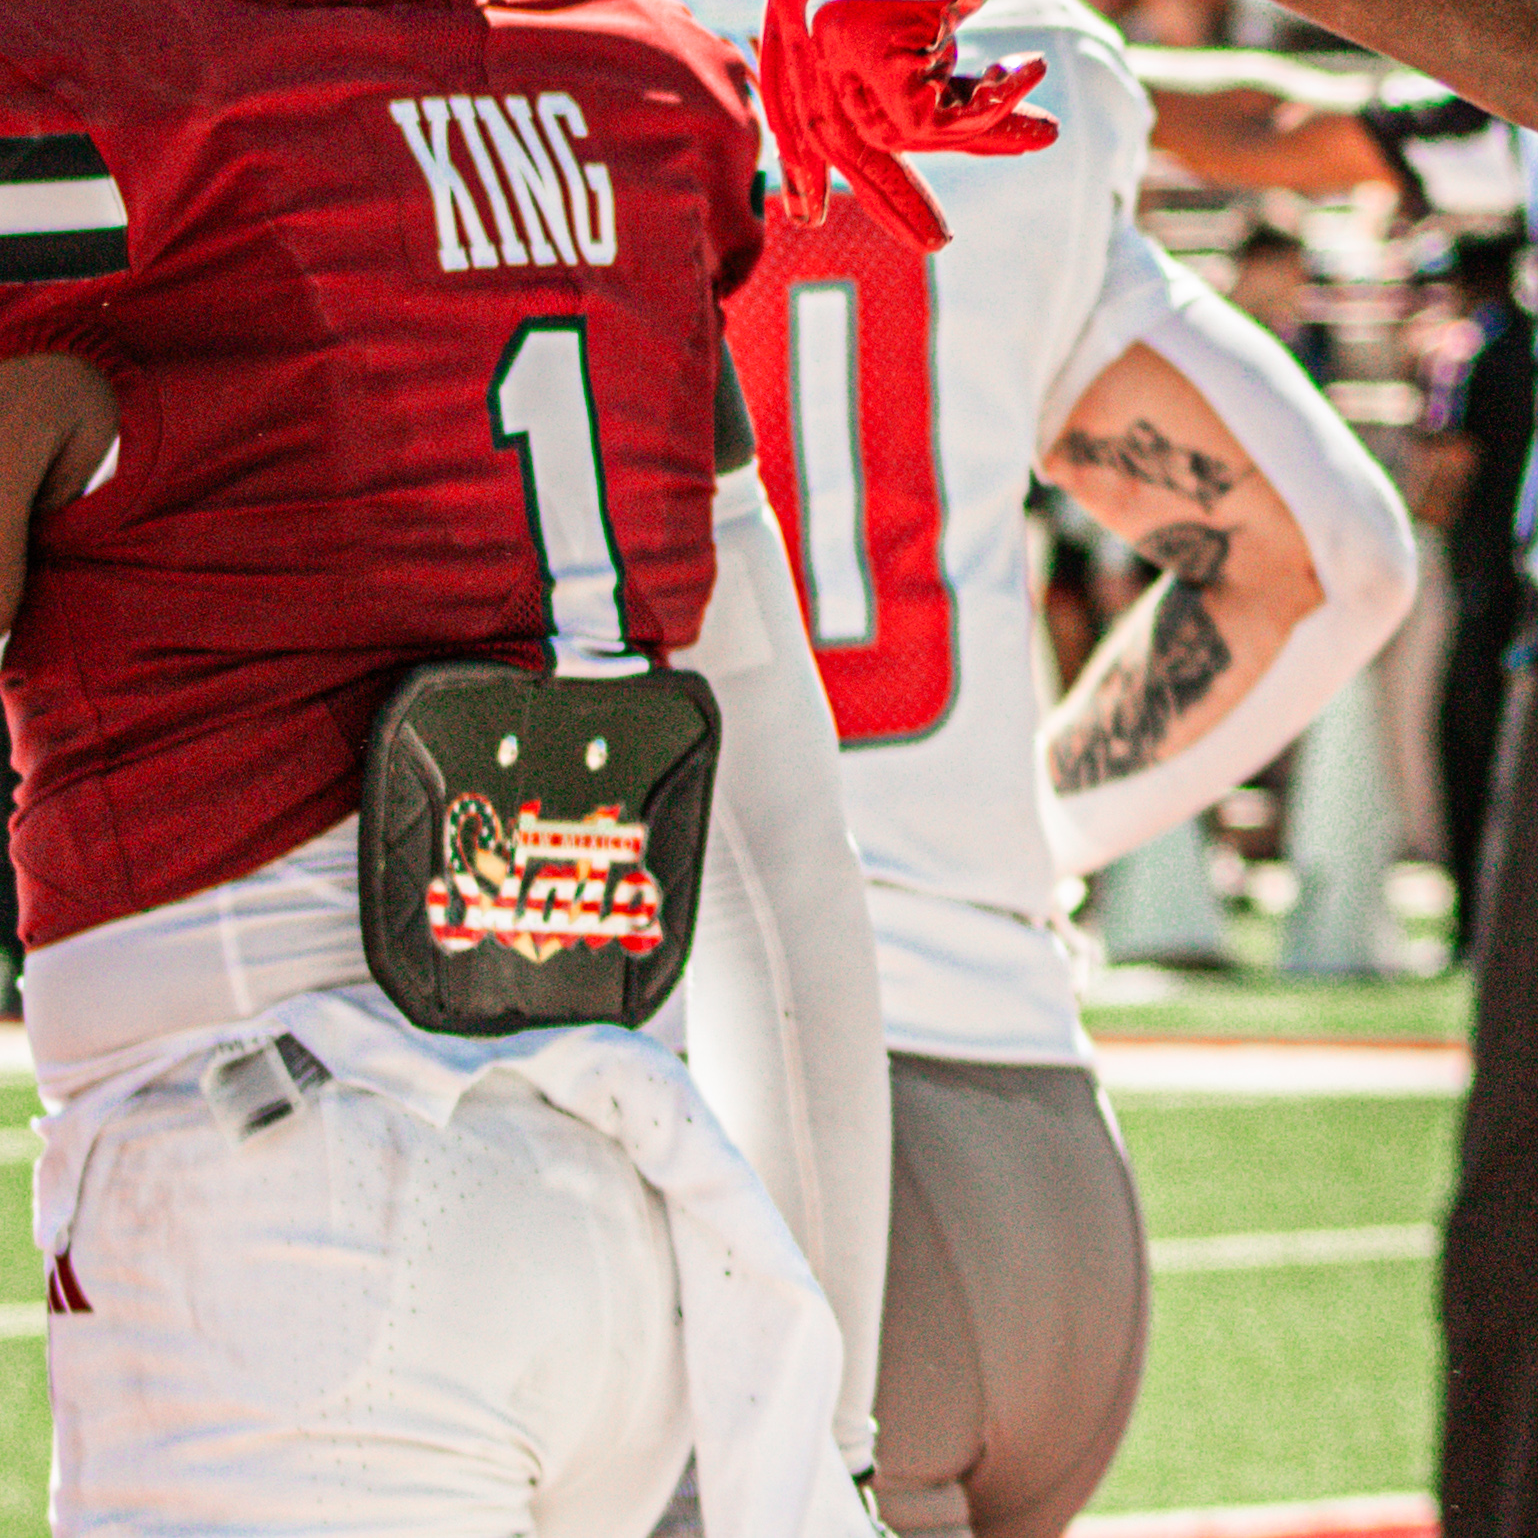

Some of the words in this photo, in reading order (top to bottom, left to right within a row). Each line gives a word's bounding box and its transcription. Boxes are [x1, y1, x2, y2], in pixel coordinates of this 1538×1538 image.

[389, 91, 617, 273] KING
[486, 315, 650, 680] 1
[426, 792, 664, 956] State
[560, 832, 637, 851] MEXICO
